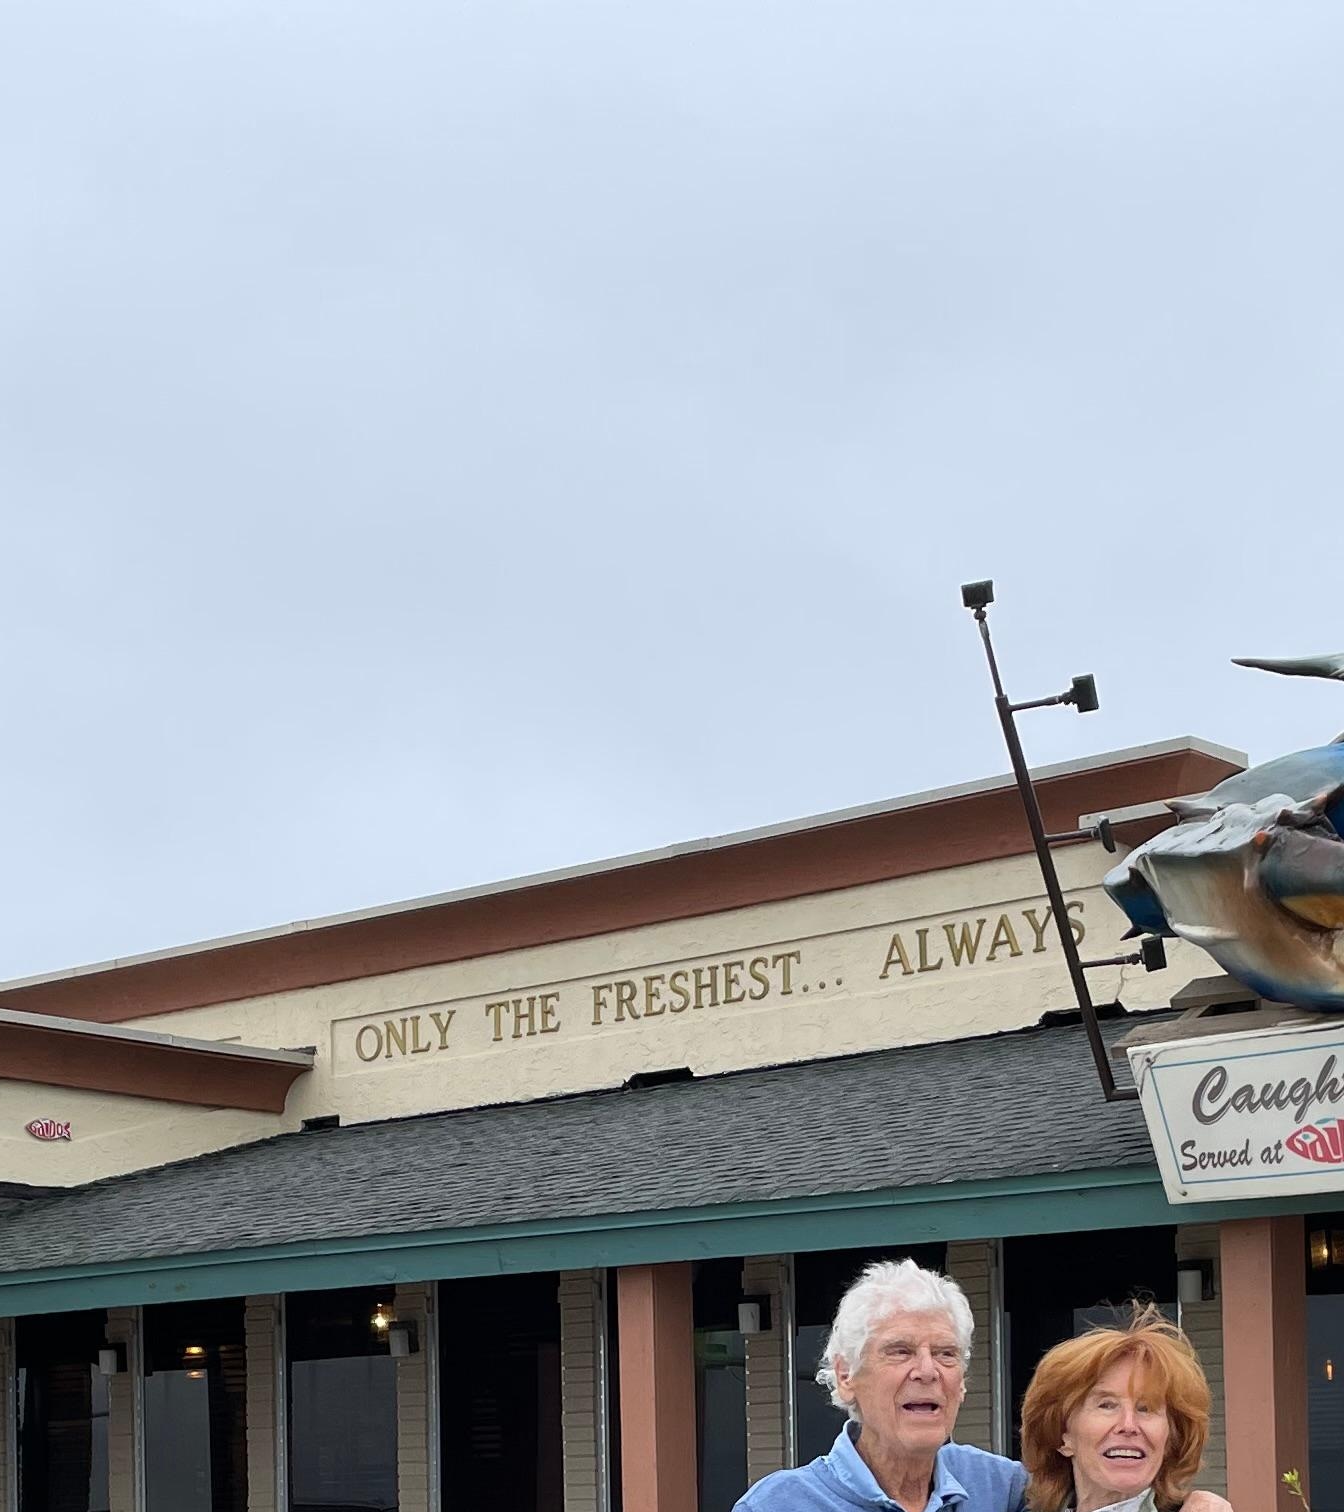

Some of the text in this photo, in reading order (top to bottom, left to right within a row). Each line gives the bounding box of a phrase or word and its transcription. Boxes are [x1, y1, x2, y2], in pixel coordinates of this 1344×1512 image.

[356, 900, 1086, 1062] ONLY THE FRESHEST... ALWAYS
[1180, 1140, 1252, 1171] Served
[1260, 1140, 1285, 1165] at
